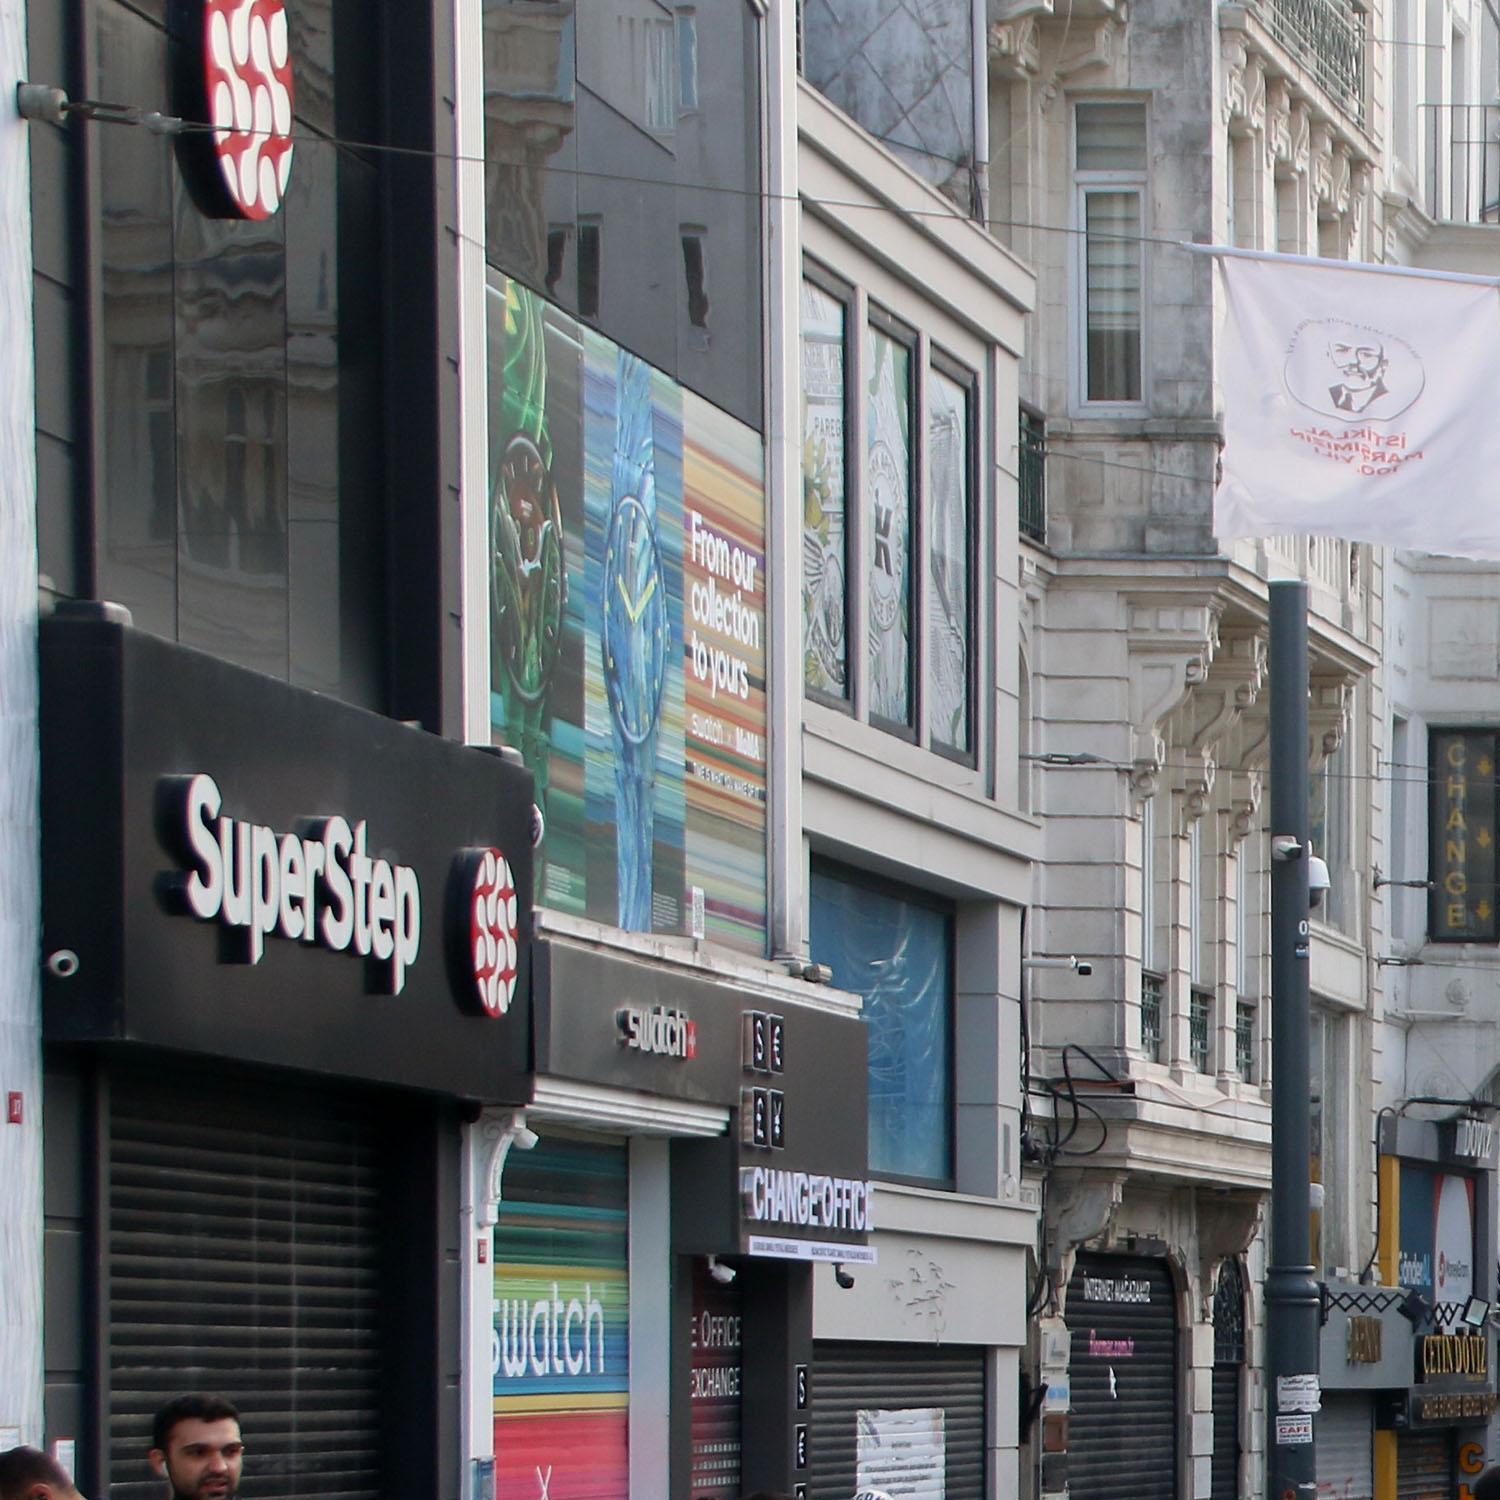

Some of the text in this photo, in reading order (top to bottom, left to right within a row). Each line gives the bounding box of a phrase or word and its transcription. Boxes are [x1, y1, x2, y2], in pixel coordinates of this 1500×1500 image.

[691, 509, 757, 593] From our
[691, 577, 759, 649] collection
[691, 630, 749, 700] to yours
[1445, 742, 1467, 927] CHANGE
[187, 773, 421, 997] SuperStep
[627, 1006, 688, 1058] swatch
[751, 1165, 875, 1231] CHANGE OFFICE
